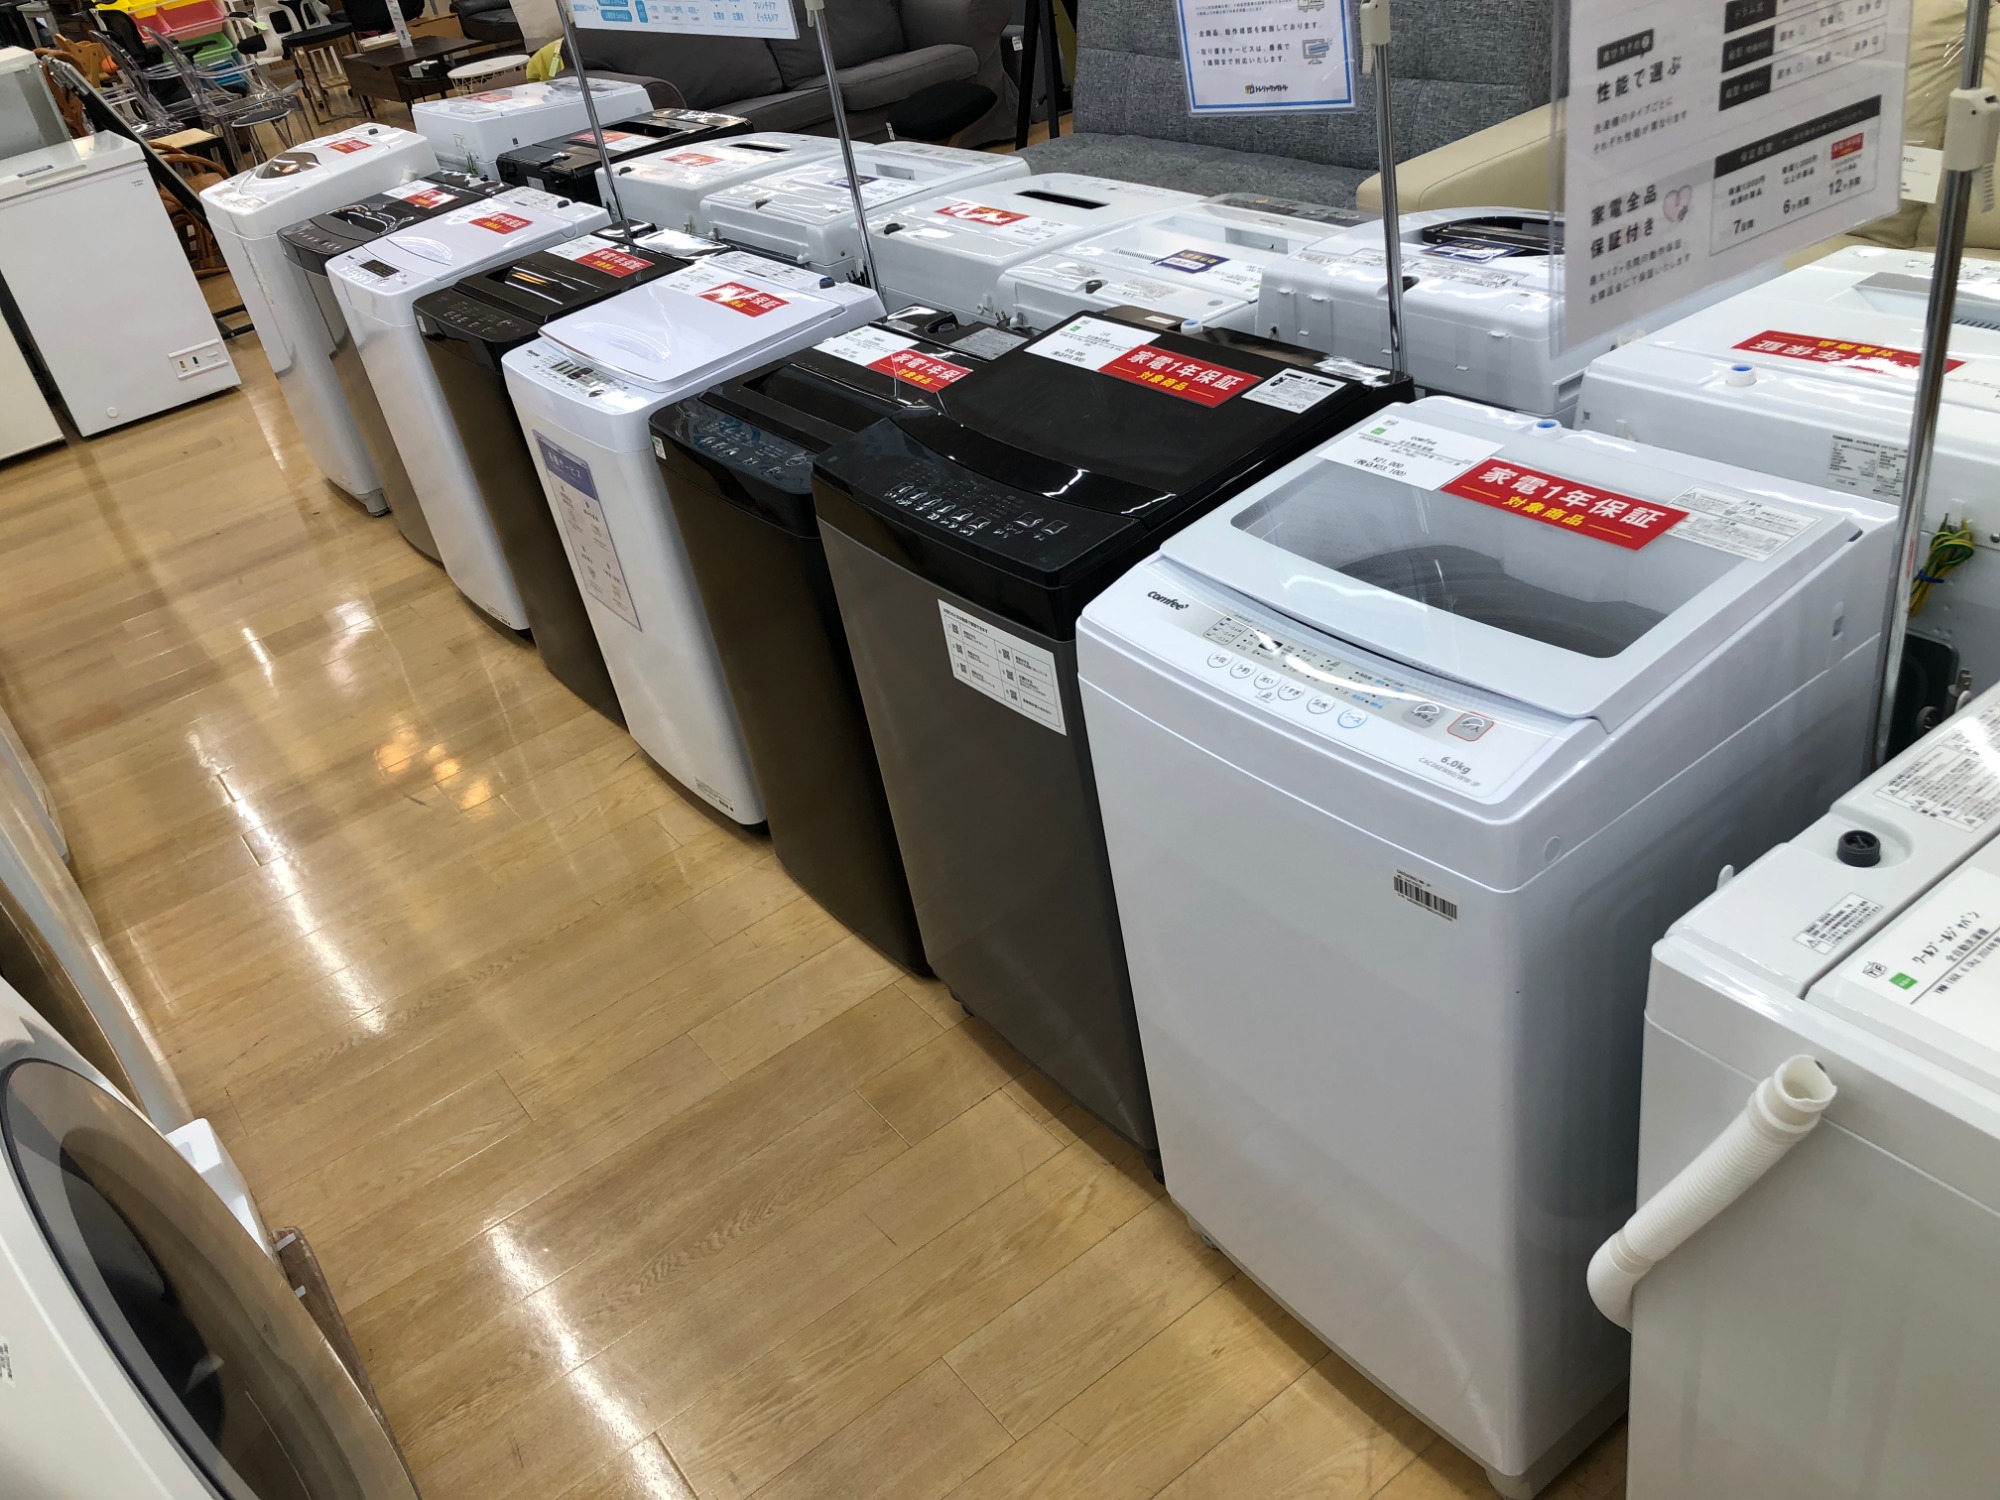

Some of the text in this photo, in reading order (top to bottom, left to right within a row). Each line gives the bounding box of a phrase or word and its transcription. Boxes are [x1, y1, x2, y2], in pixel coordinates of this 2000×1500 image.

[1596, 56, 1682, 104] 性能で選ぶ
[1591, 184, 1657, 227] 家電全品
[1591, 217, 1654, 259] 保証付き
[1127, 350, 1245, 391] 家電1年保証
[1136, 370, 1190, 392] 対象商品
[1478, 466, 1668, 529] 家電1年保証
[1501, 495, 1587, 528] 対象商品
[1440, 755, 1473, 776] 6.0kg
